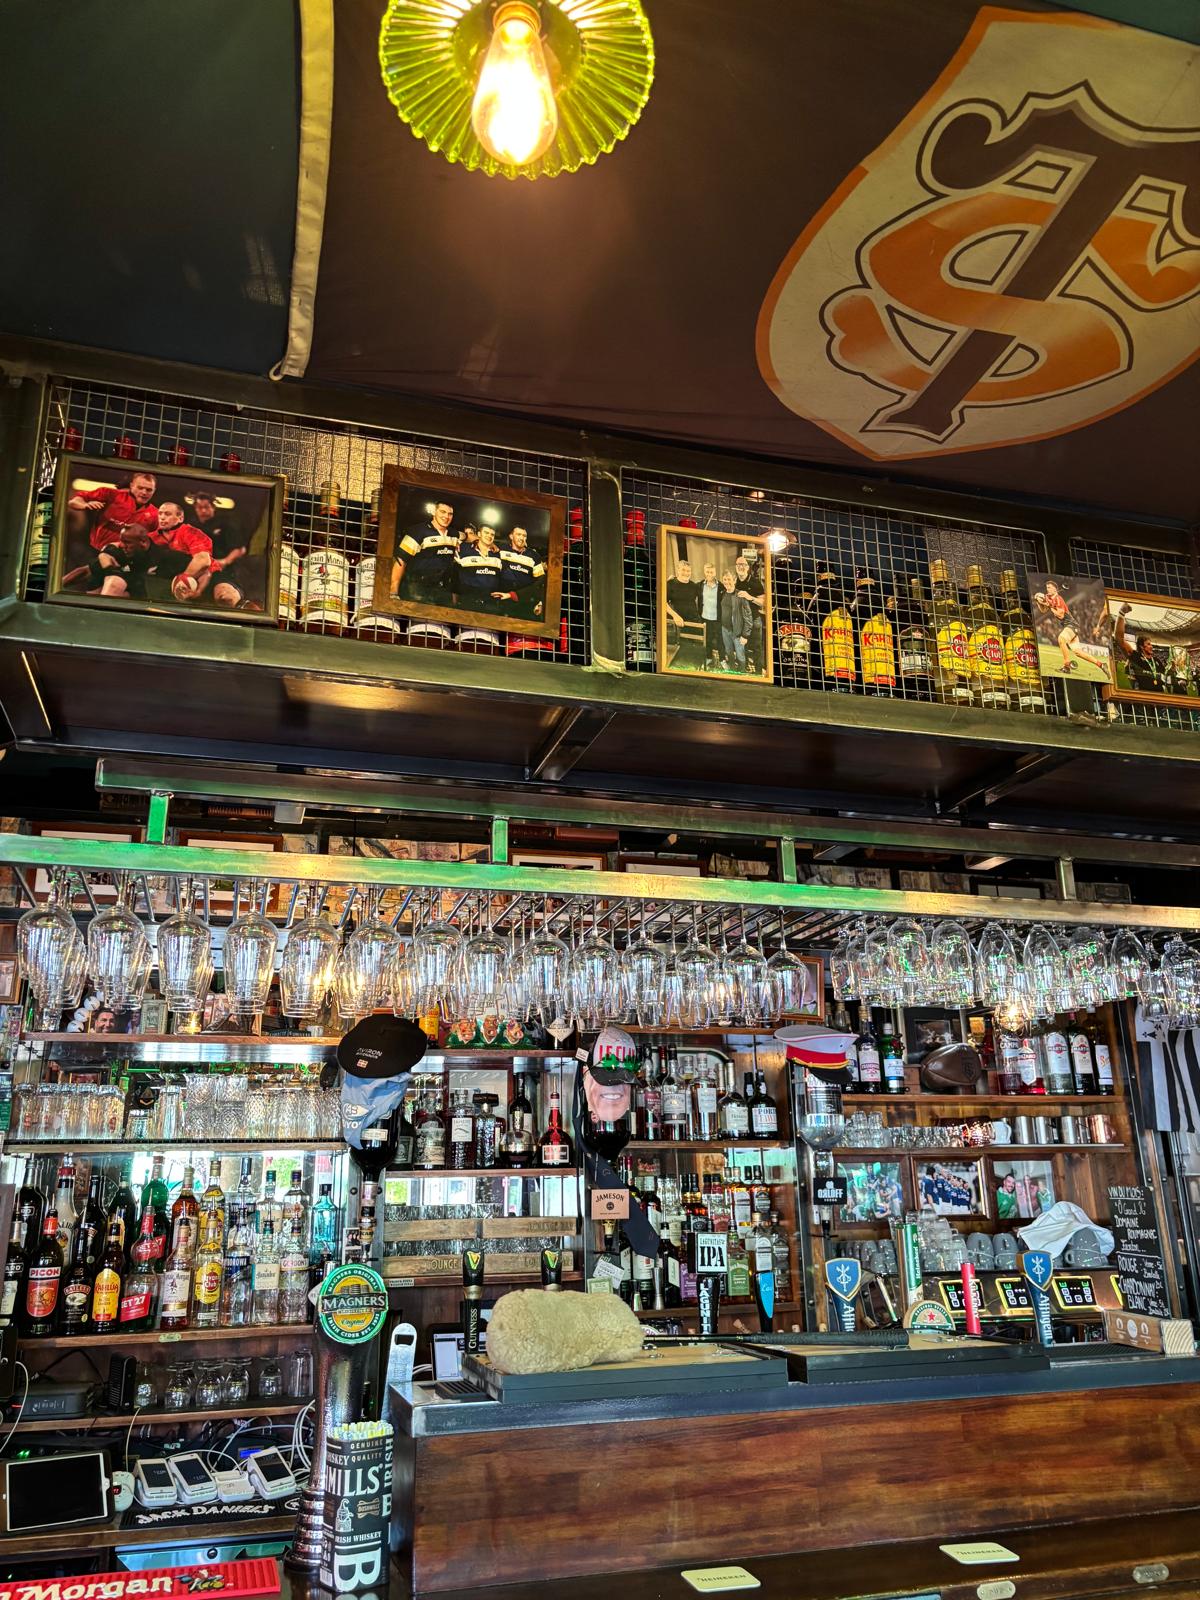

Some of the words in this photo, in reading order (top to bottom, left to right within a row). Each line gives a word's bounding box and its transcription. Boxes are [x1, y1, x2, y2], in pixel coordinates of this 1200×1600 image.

[596, 1192, 625, 1203] JAMESON
[1114, 1215, 1139, 1228] DOMAINE
[700, 1246, 725, 1267] IPA
[913, 1246, 921, 1279] Heineken
[1117, 1255, 1139, 1273] ROUGE
[30, 1268, 60, 1278] PICON
[353, 1269, 379, 1290] ORIGINAL
[134, 1296, 146, 1306] 27
[323, 1295, 385, 1310] MAGNERS
[1127, 1294, 1147, 1310] BLANC
[1038, 1293, 1053, 1340] Affligem
[327, 1316, 340, 1334] IRISH
[468, 1308, 478, 1349] GUINNESS
[350, 1439, 384, 1450] GENUINE
[351, 1452, 383, 1463] QUALITY
[384, 1438, 394, 1488] IRISH
[136, 1508, 190, 1524] JACK
[353, 1530, 382, 1543] WHISKEY
[17, 1575, 173, 1600] Morgan
